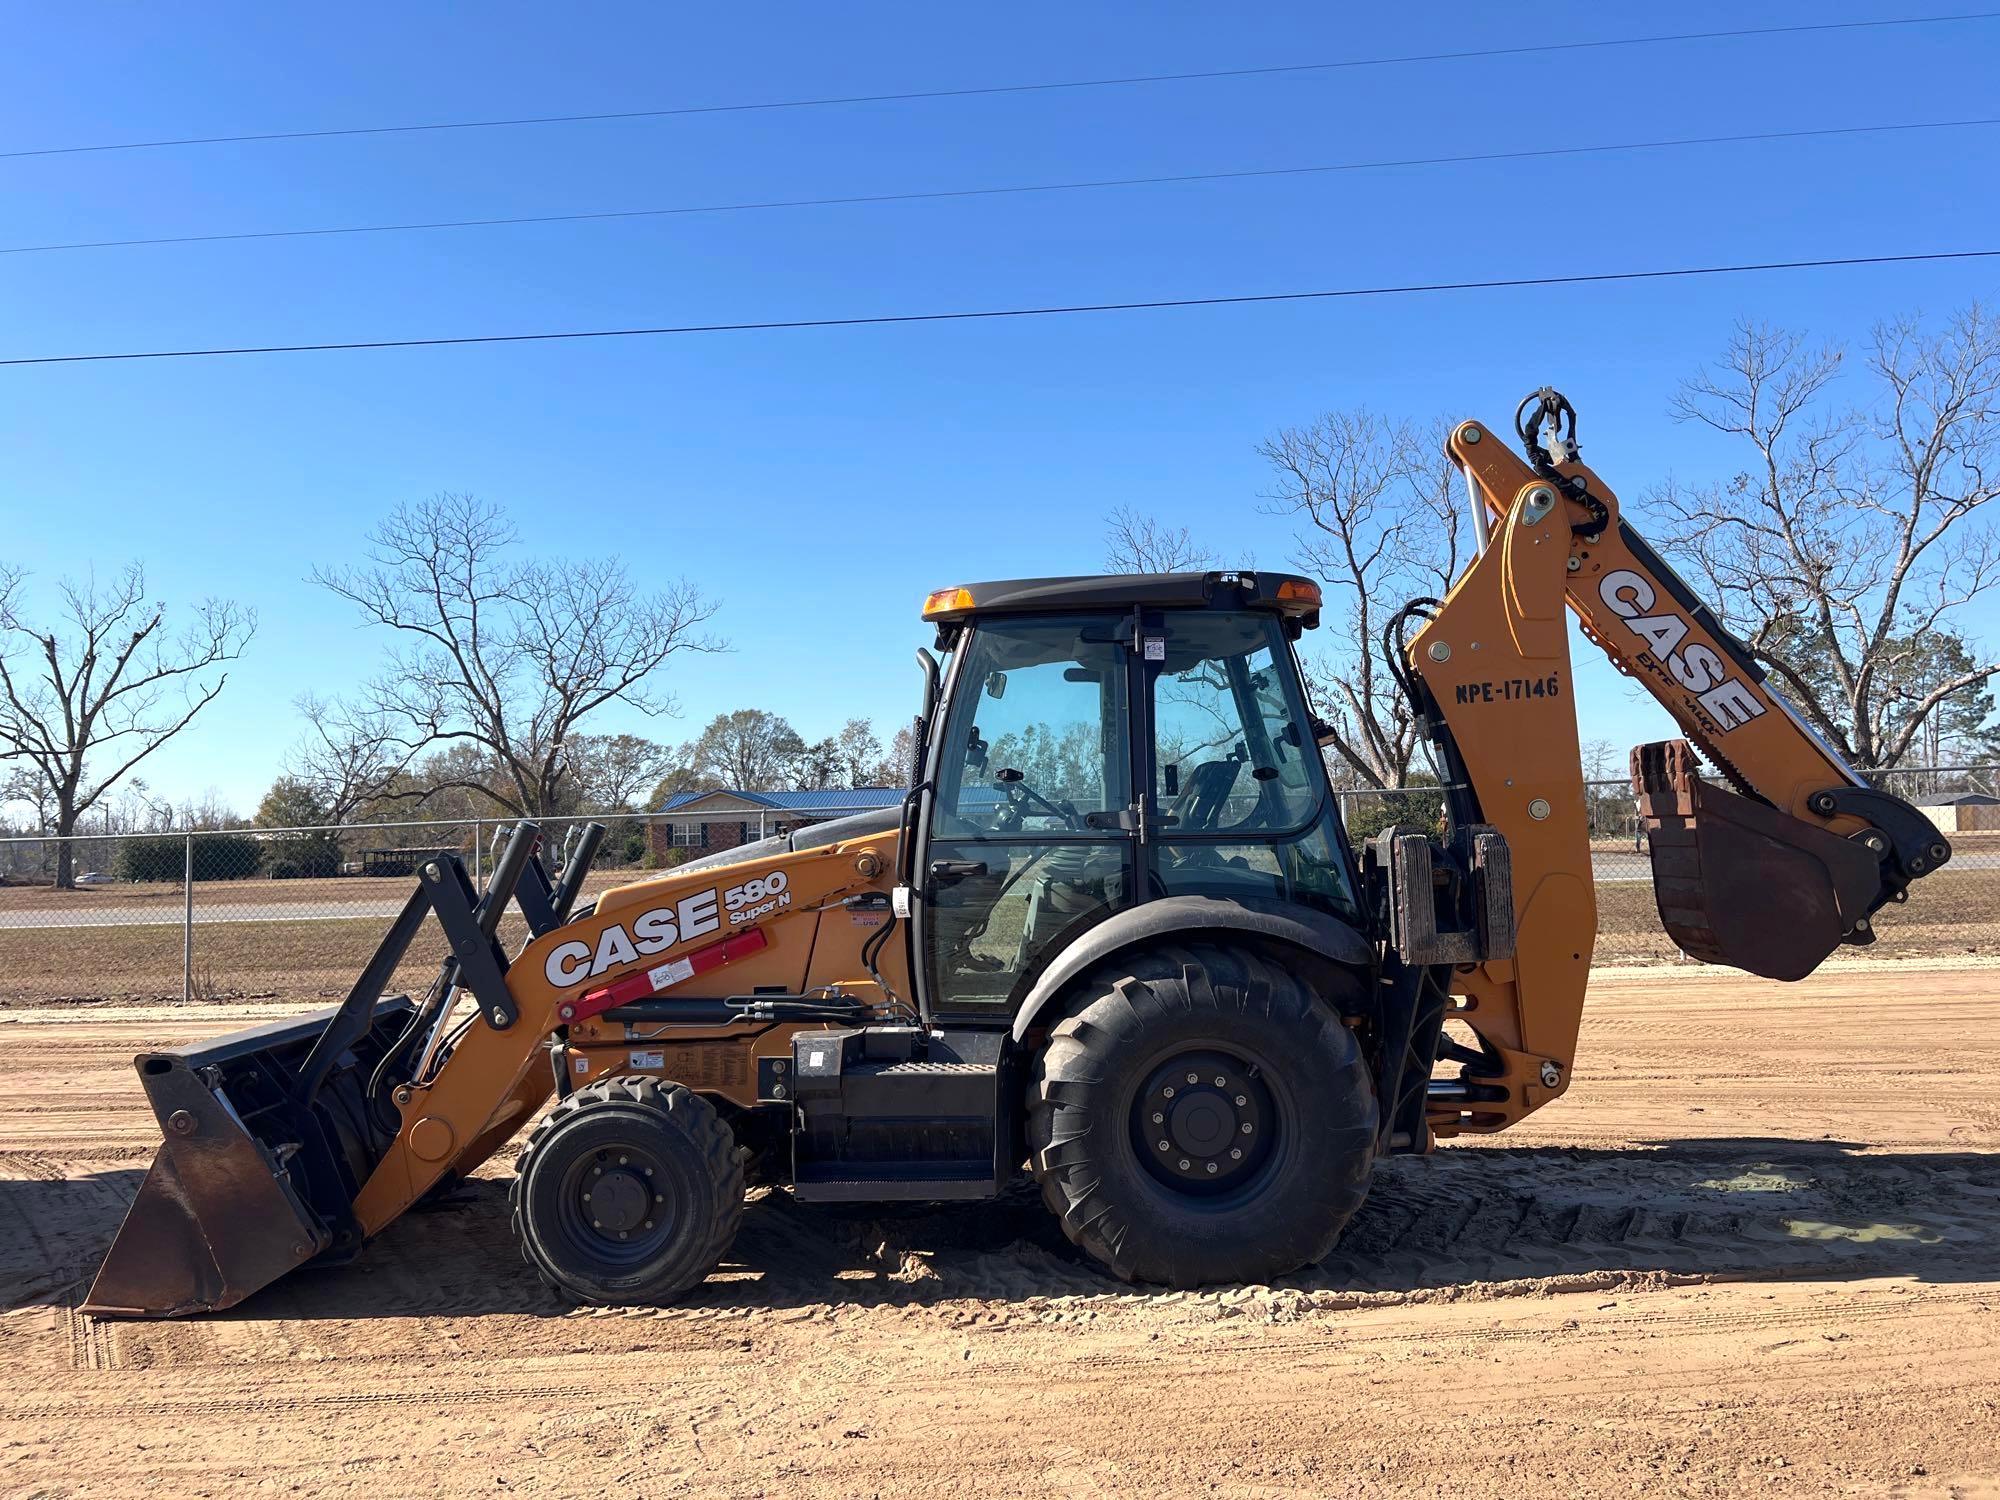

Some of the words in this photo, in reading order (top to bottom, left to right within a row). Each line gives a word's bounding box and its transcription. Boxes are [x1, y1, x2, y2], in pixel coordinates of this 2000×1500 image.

[1598, 569, 1768, 733] CASE
[1455, 677, 1559, 704] NPE-17146
[723, 871, 789, 911] 580
[729, 899, 776, 925] Super
[778, 891, 791, 907] N
[544, 887, 722, 988] CASE
